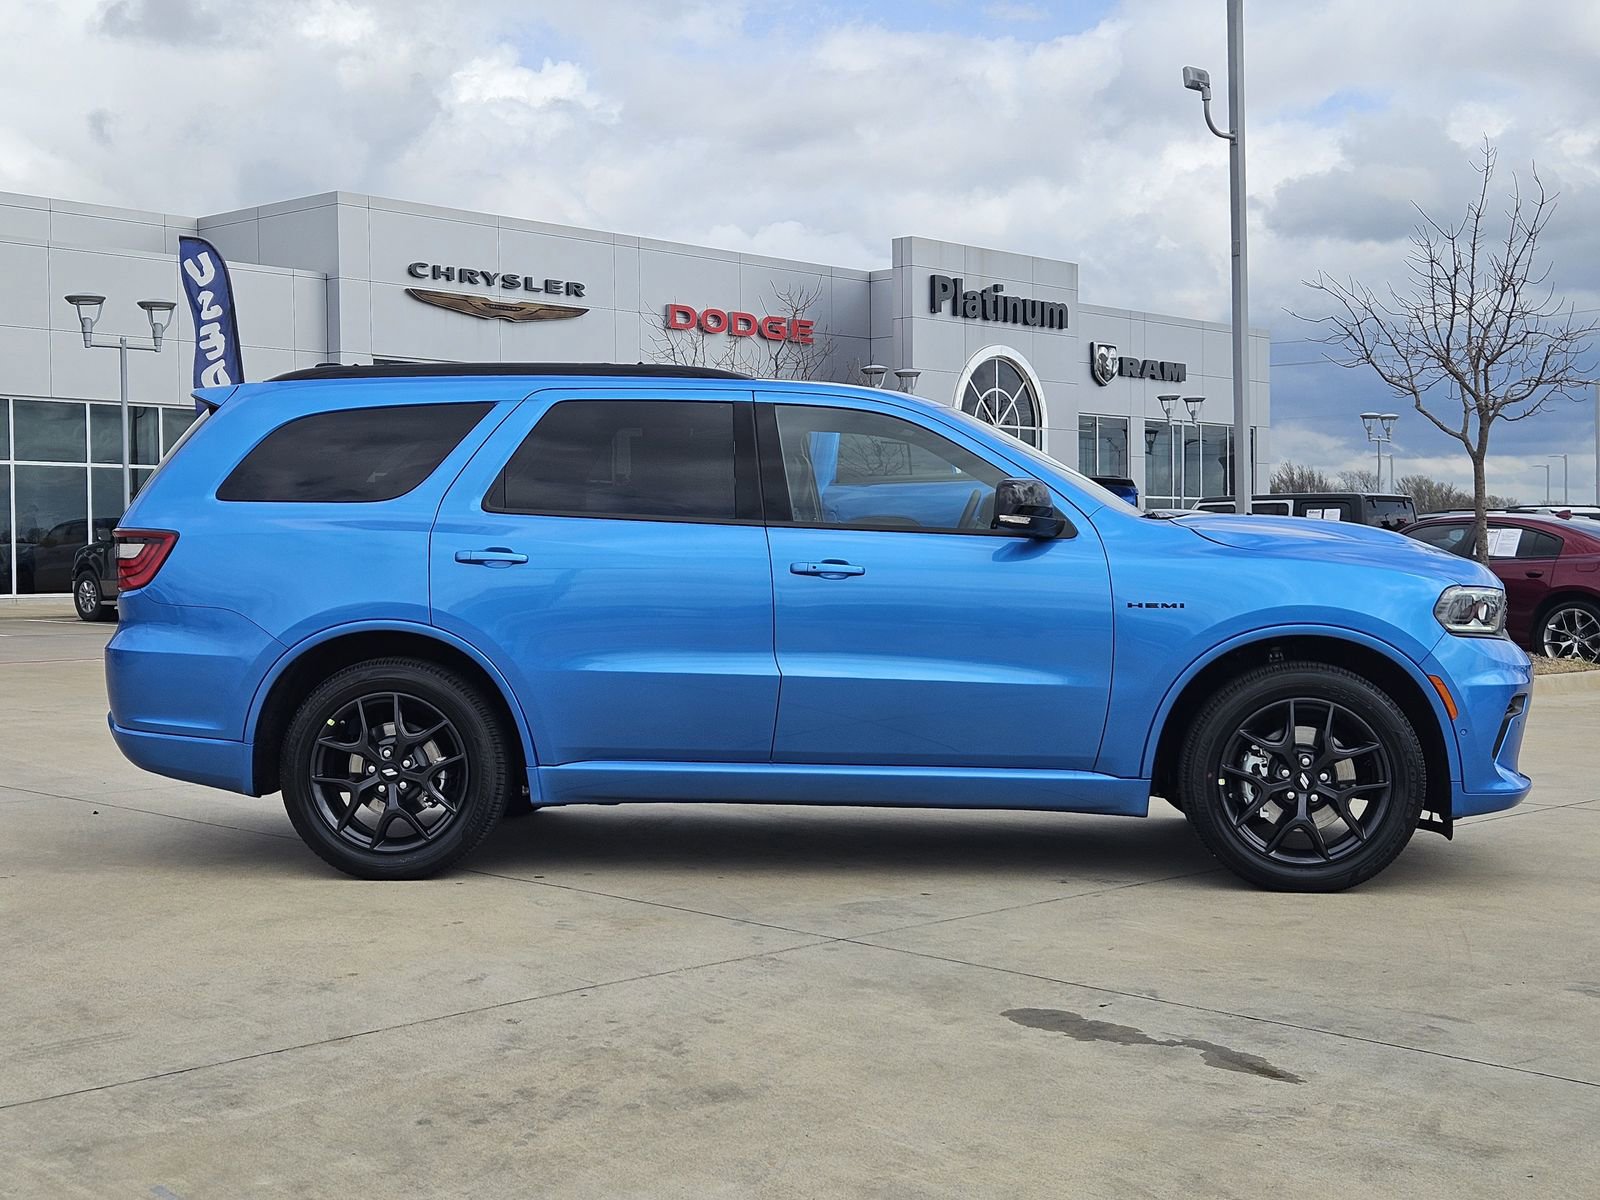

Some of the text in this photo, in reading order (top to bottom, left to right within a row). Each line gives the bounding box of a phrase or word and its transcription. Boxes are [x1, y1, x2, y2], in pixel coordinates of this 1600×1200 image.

[407, 262, 586, 297] CHRYSLER
[930, 274, 1069, 329] Platinum
[665, 303, 815, 344] DODGE
[1118, 356, 1187, 382] RAM
